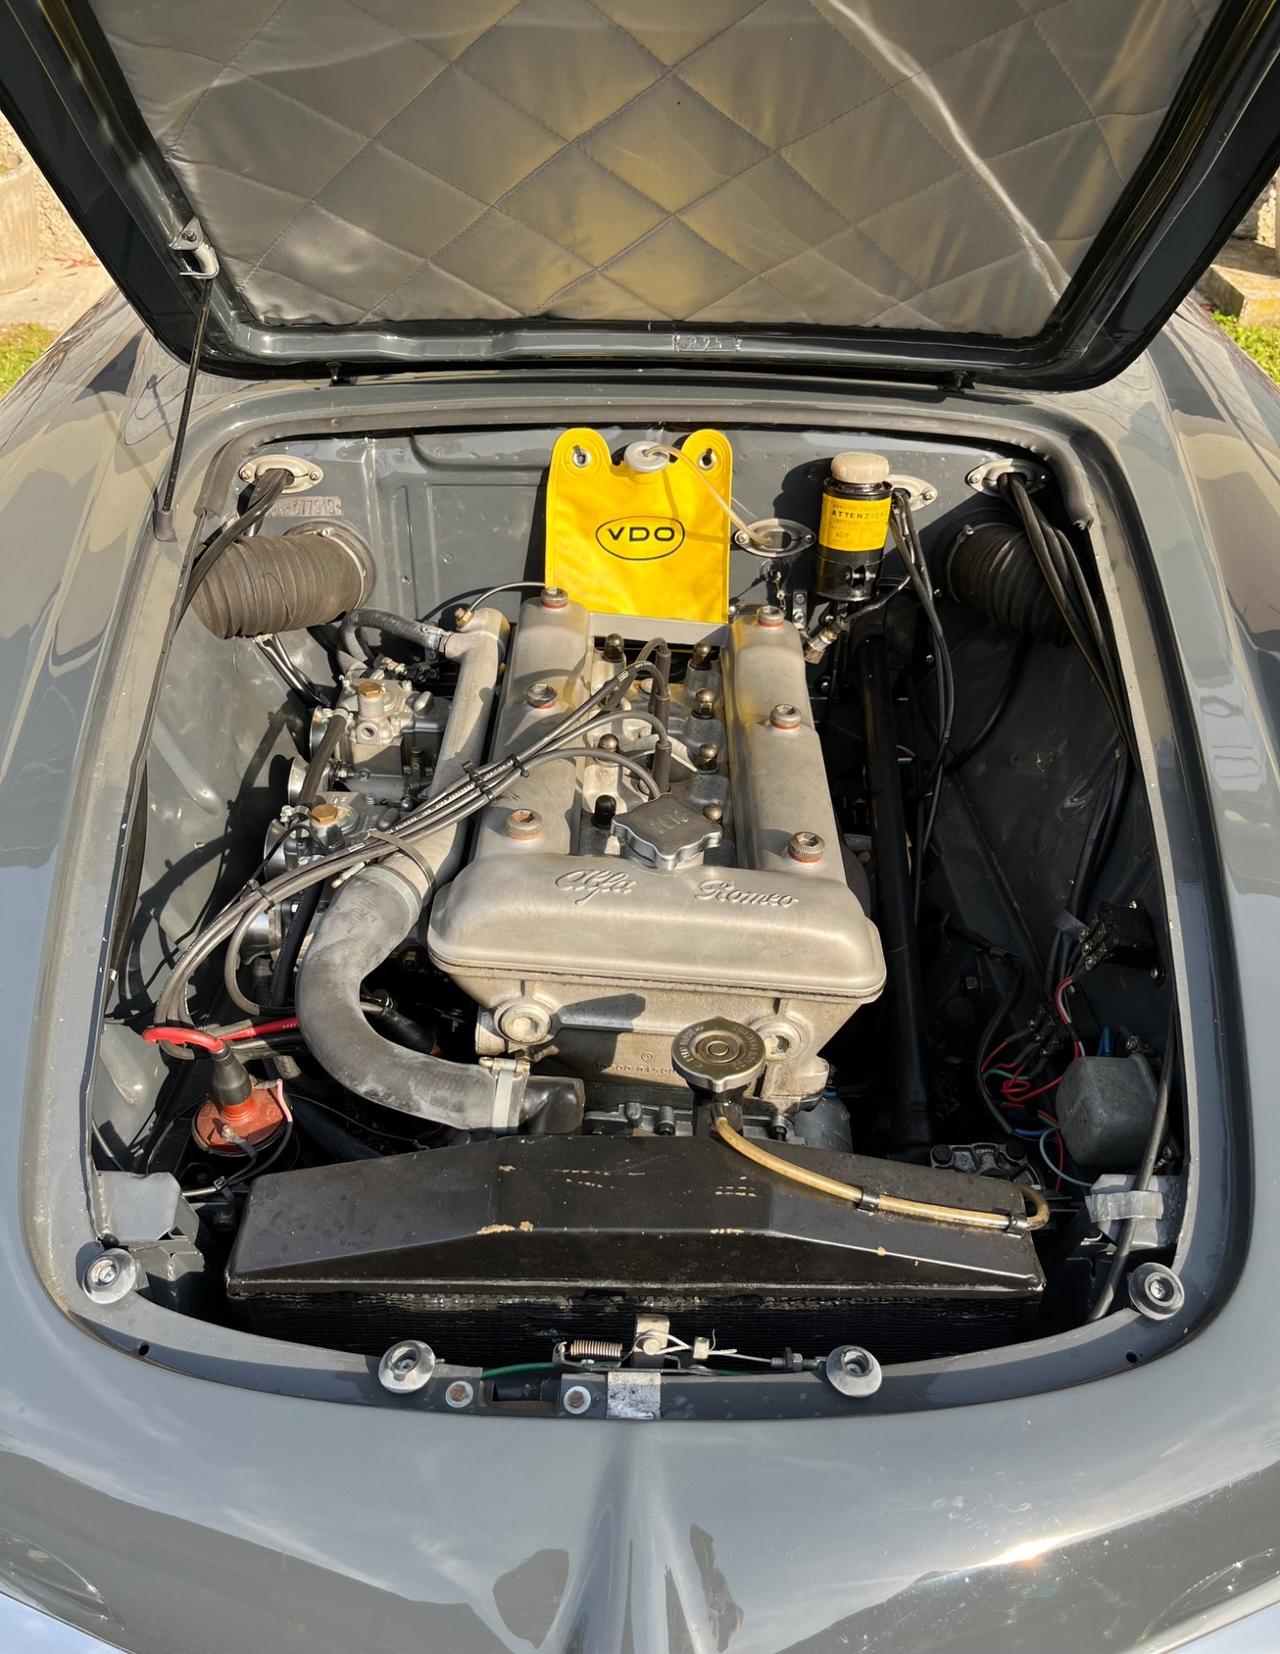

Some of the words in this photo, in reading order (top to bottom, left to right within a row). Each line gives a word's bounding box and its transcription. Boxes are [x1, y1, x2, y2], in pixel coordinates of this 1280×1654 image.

[607, 526, 675, 541] VDO
[555, 868, 637, 904] Alfa
[695, 879, 798, 908] Romeo
